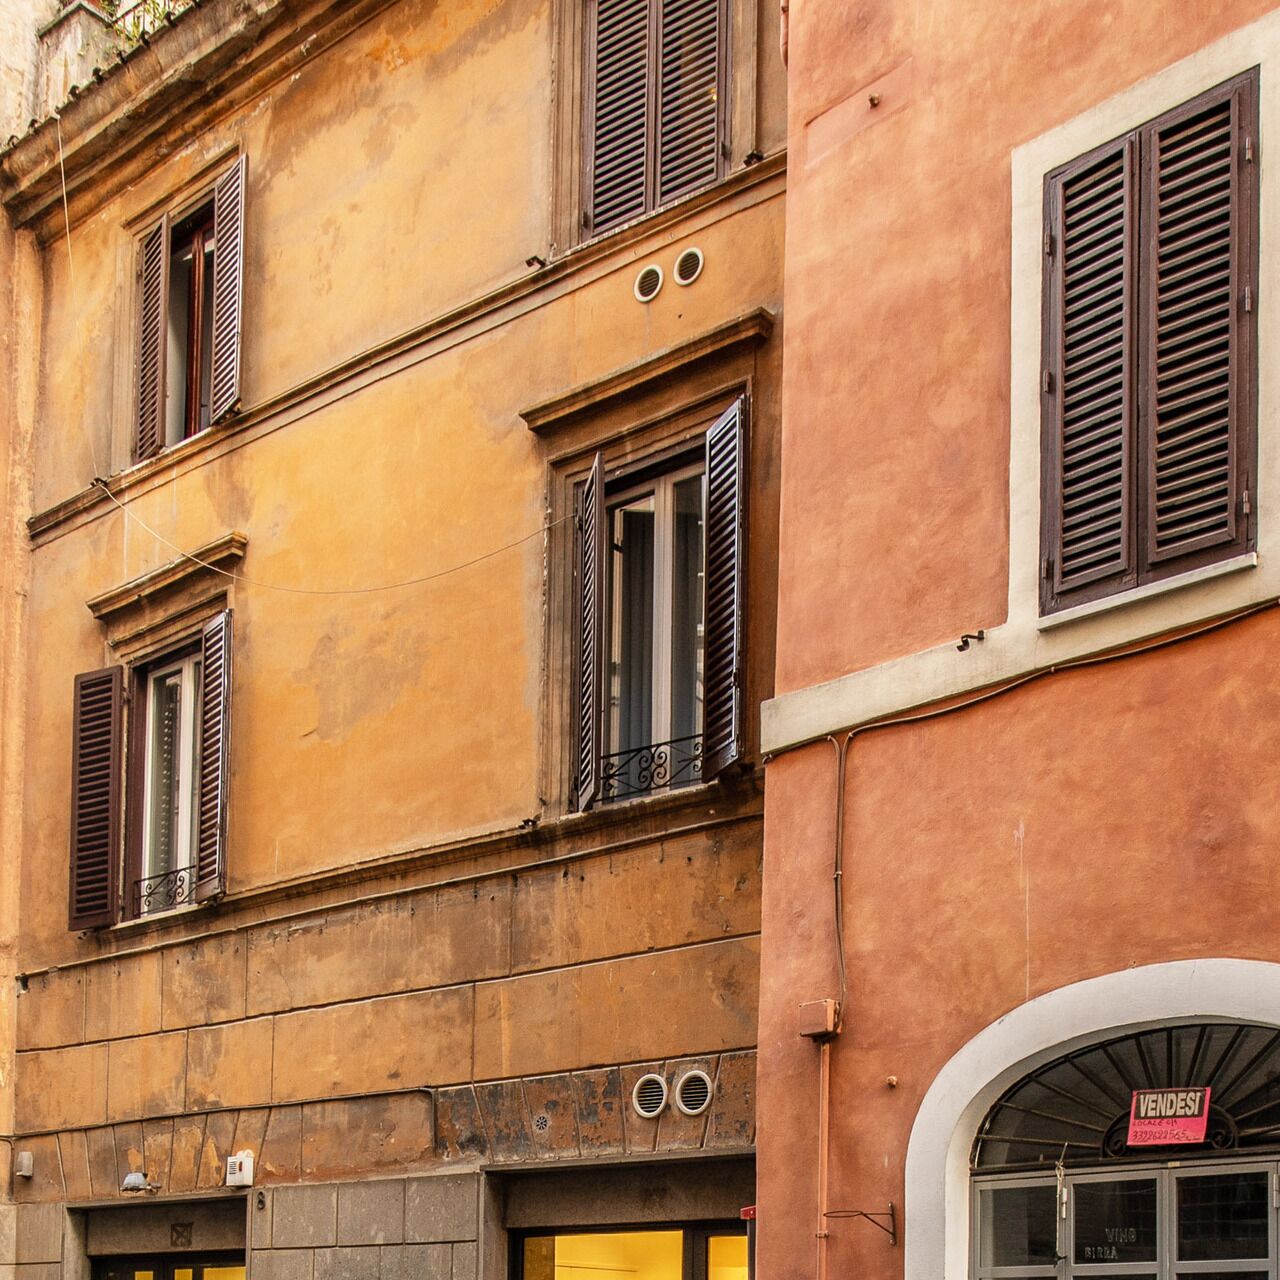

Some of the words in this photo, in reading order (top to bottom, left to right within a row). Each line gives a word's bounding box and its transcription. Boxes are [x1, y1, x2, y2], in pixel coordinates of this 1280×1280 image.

[1140, 1091, 1201, 1117] VENDESI
[257, 1191, 265, 1210] 8
[1105, 1227, 1136, 1242] VINO
[1084, 1246, 1118, 1259] BIRRA
